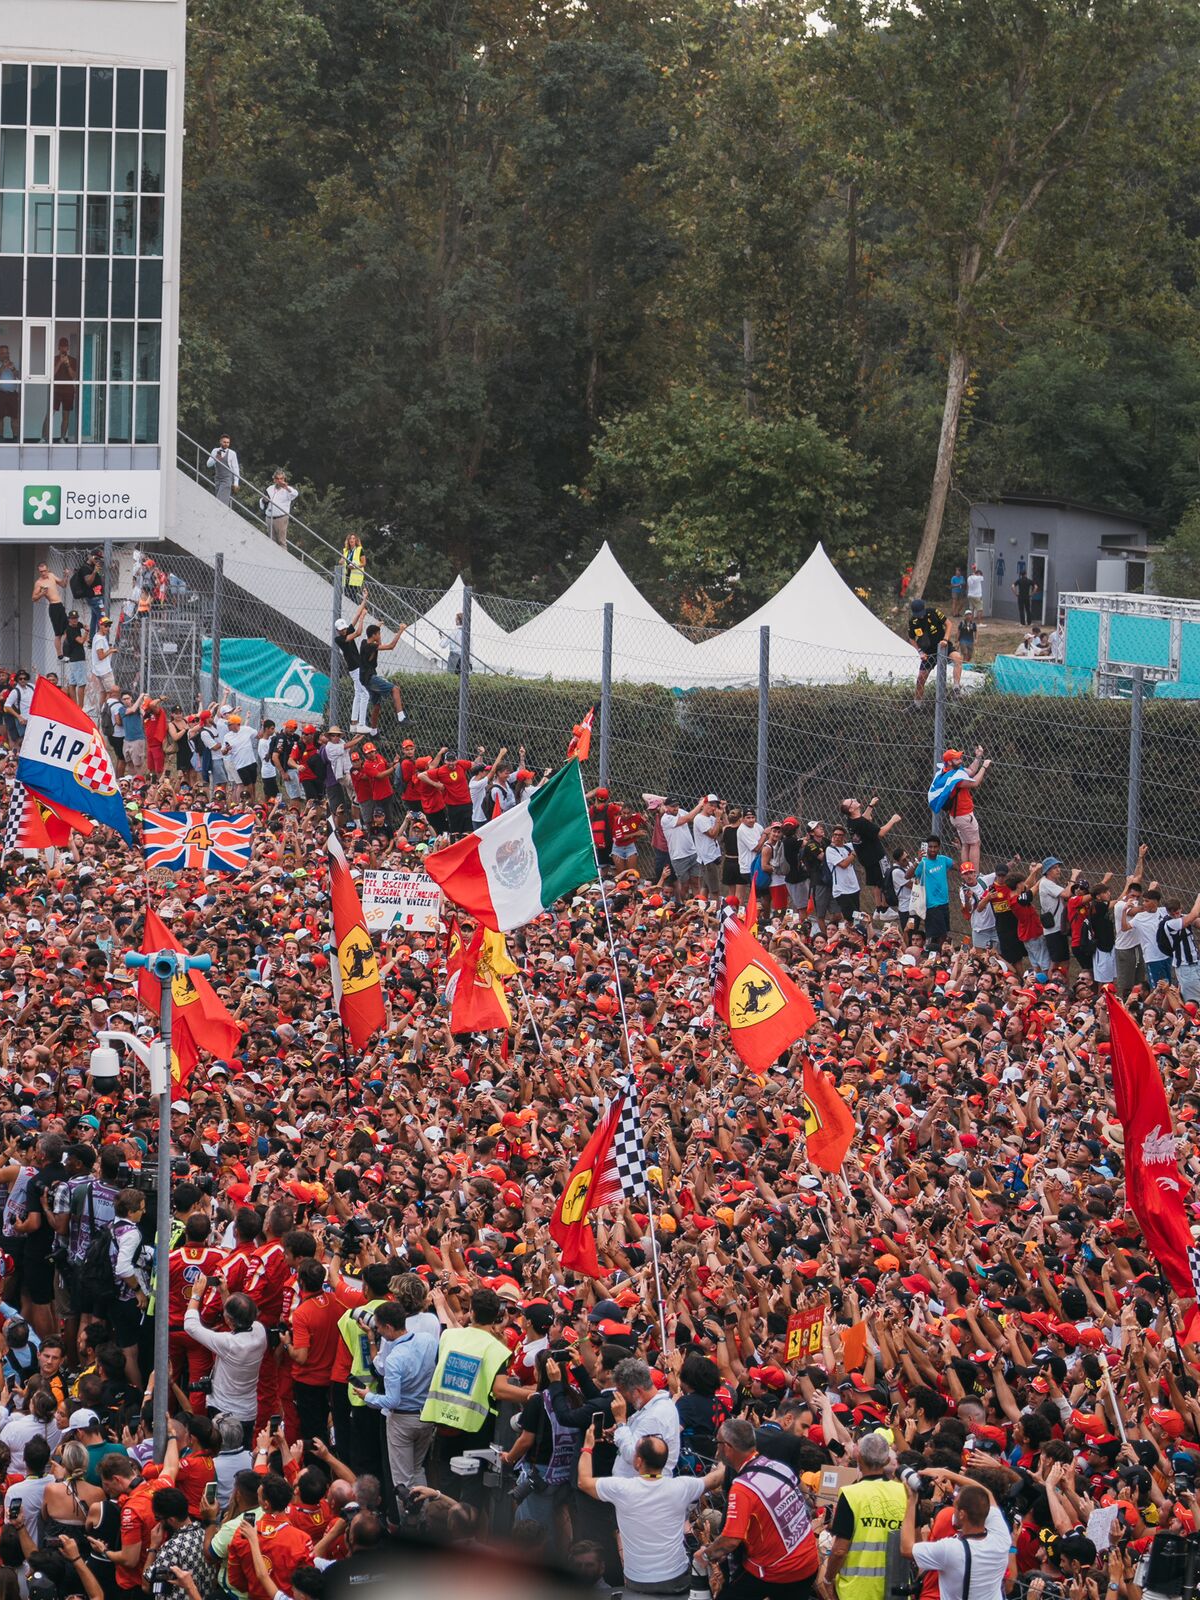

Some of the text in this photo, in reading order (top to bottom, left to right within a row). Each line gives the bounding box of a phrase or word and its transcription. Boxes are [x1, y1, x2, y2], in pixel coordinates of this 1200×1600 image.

[66, 490, 130, 505] Regione
[66, 507, 148, 520] Lombardia
[40, 722, 85, 763] ČAP
[182, 823, 215, 850] 4
[365, 872, 377, 880] NON
[394, 873, 411, 881] SONO
[416, 874, 434, 883] PARO
[445, 1354, 478, 1373] STEWARD
